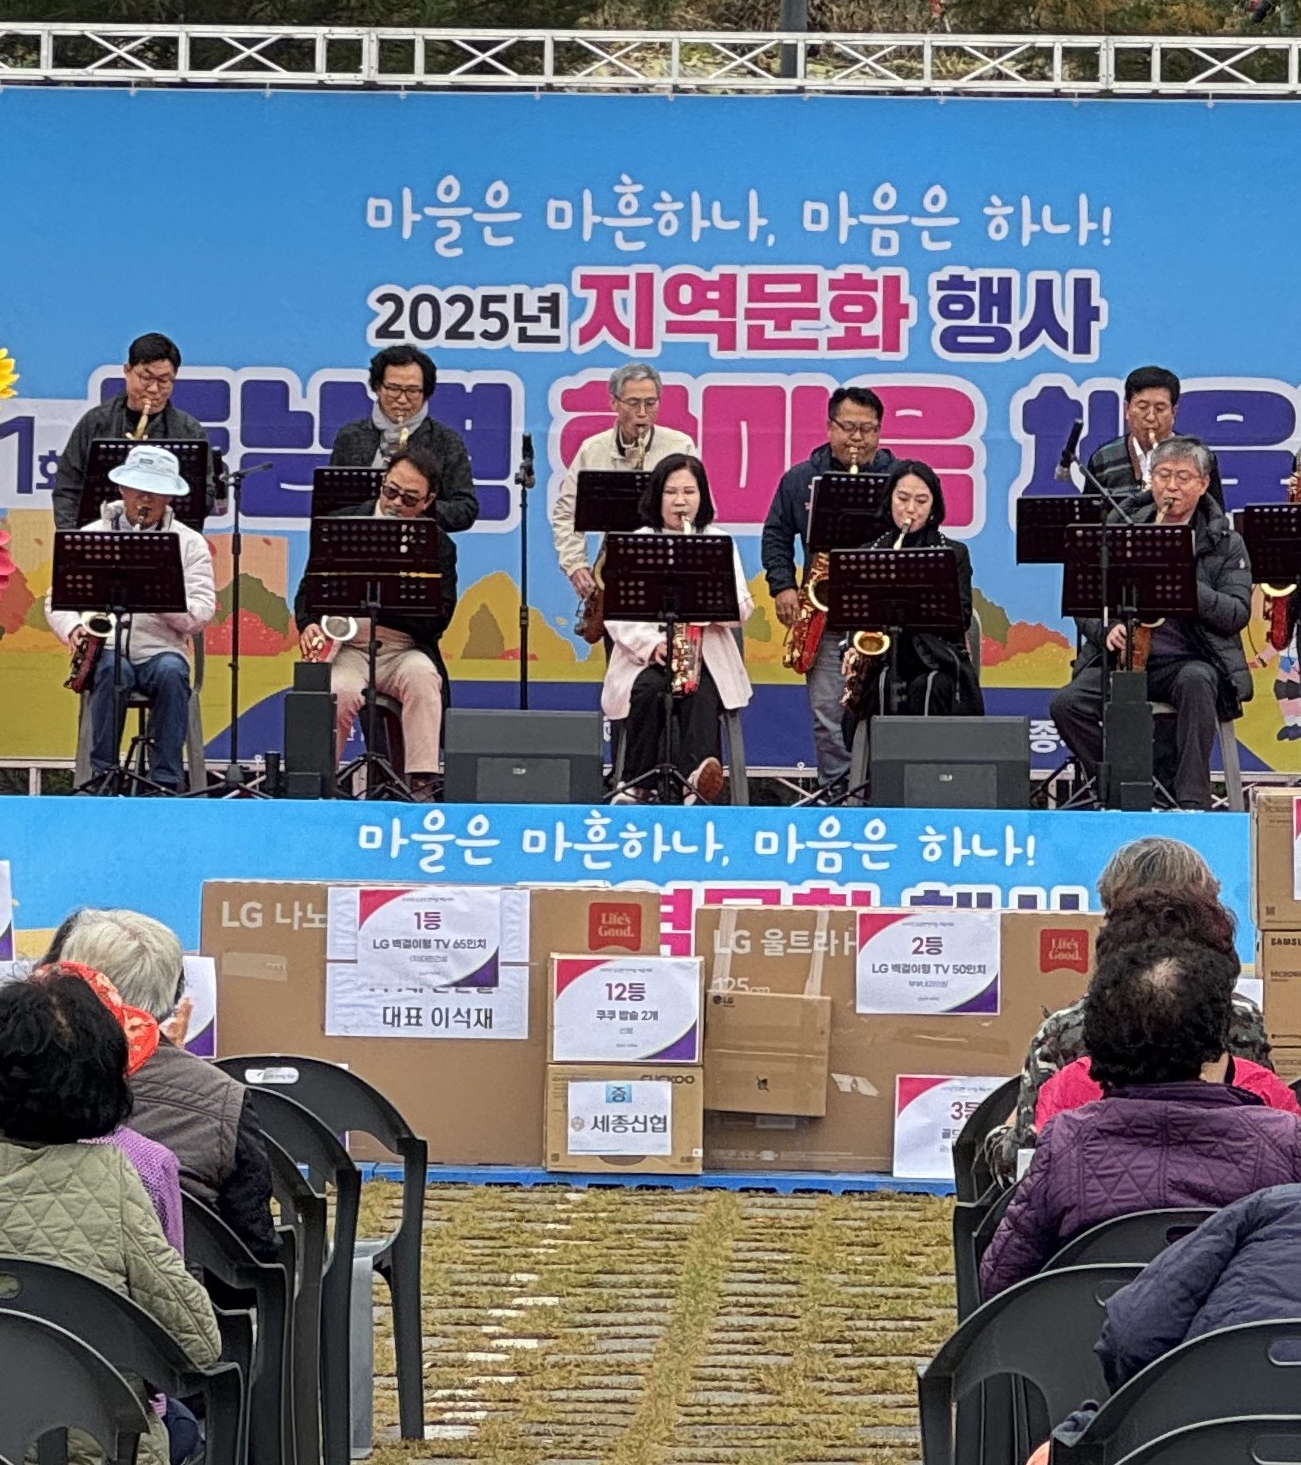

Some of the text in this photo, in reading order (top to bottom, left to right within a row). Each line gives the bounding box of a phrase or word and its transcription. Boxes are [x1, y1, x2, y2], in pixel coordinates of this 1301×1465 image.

[366, 174, 1113, 258] 마을은 마흔하나, 마음은 하나!
[373, 271, 1101, 355] 2025년 지역문화 행사
[358, 810, 1037, 875] 마을은 마흔하나, 마음은 하나!
[221, 901, 263, 929] LG
[413, 911, 442, 931] 1등
[601, 912, 631, 926] Life's
[372, 938, 487, 950] LG 벽걸이형 TV 65인치
[713, 929, 751, 955] LG
[760, 928, 840, 957] 울트라
[911, 936, 944, 956] 2등
[871, 964, 987, 974] LG 벽걸이형 TV 50인치
[605, 982, 647, 1002] 12등
[382, 1006, 494, 1030] 대표 이석재
[596, 1010, 659, 1021] 쿠쿠 밥솥 2개
[590, 1114, 668, 1134] 세종신협
